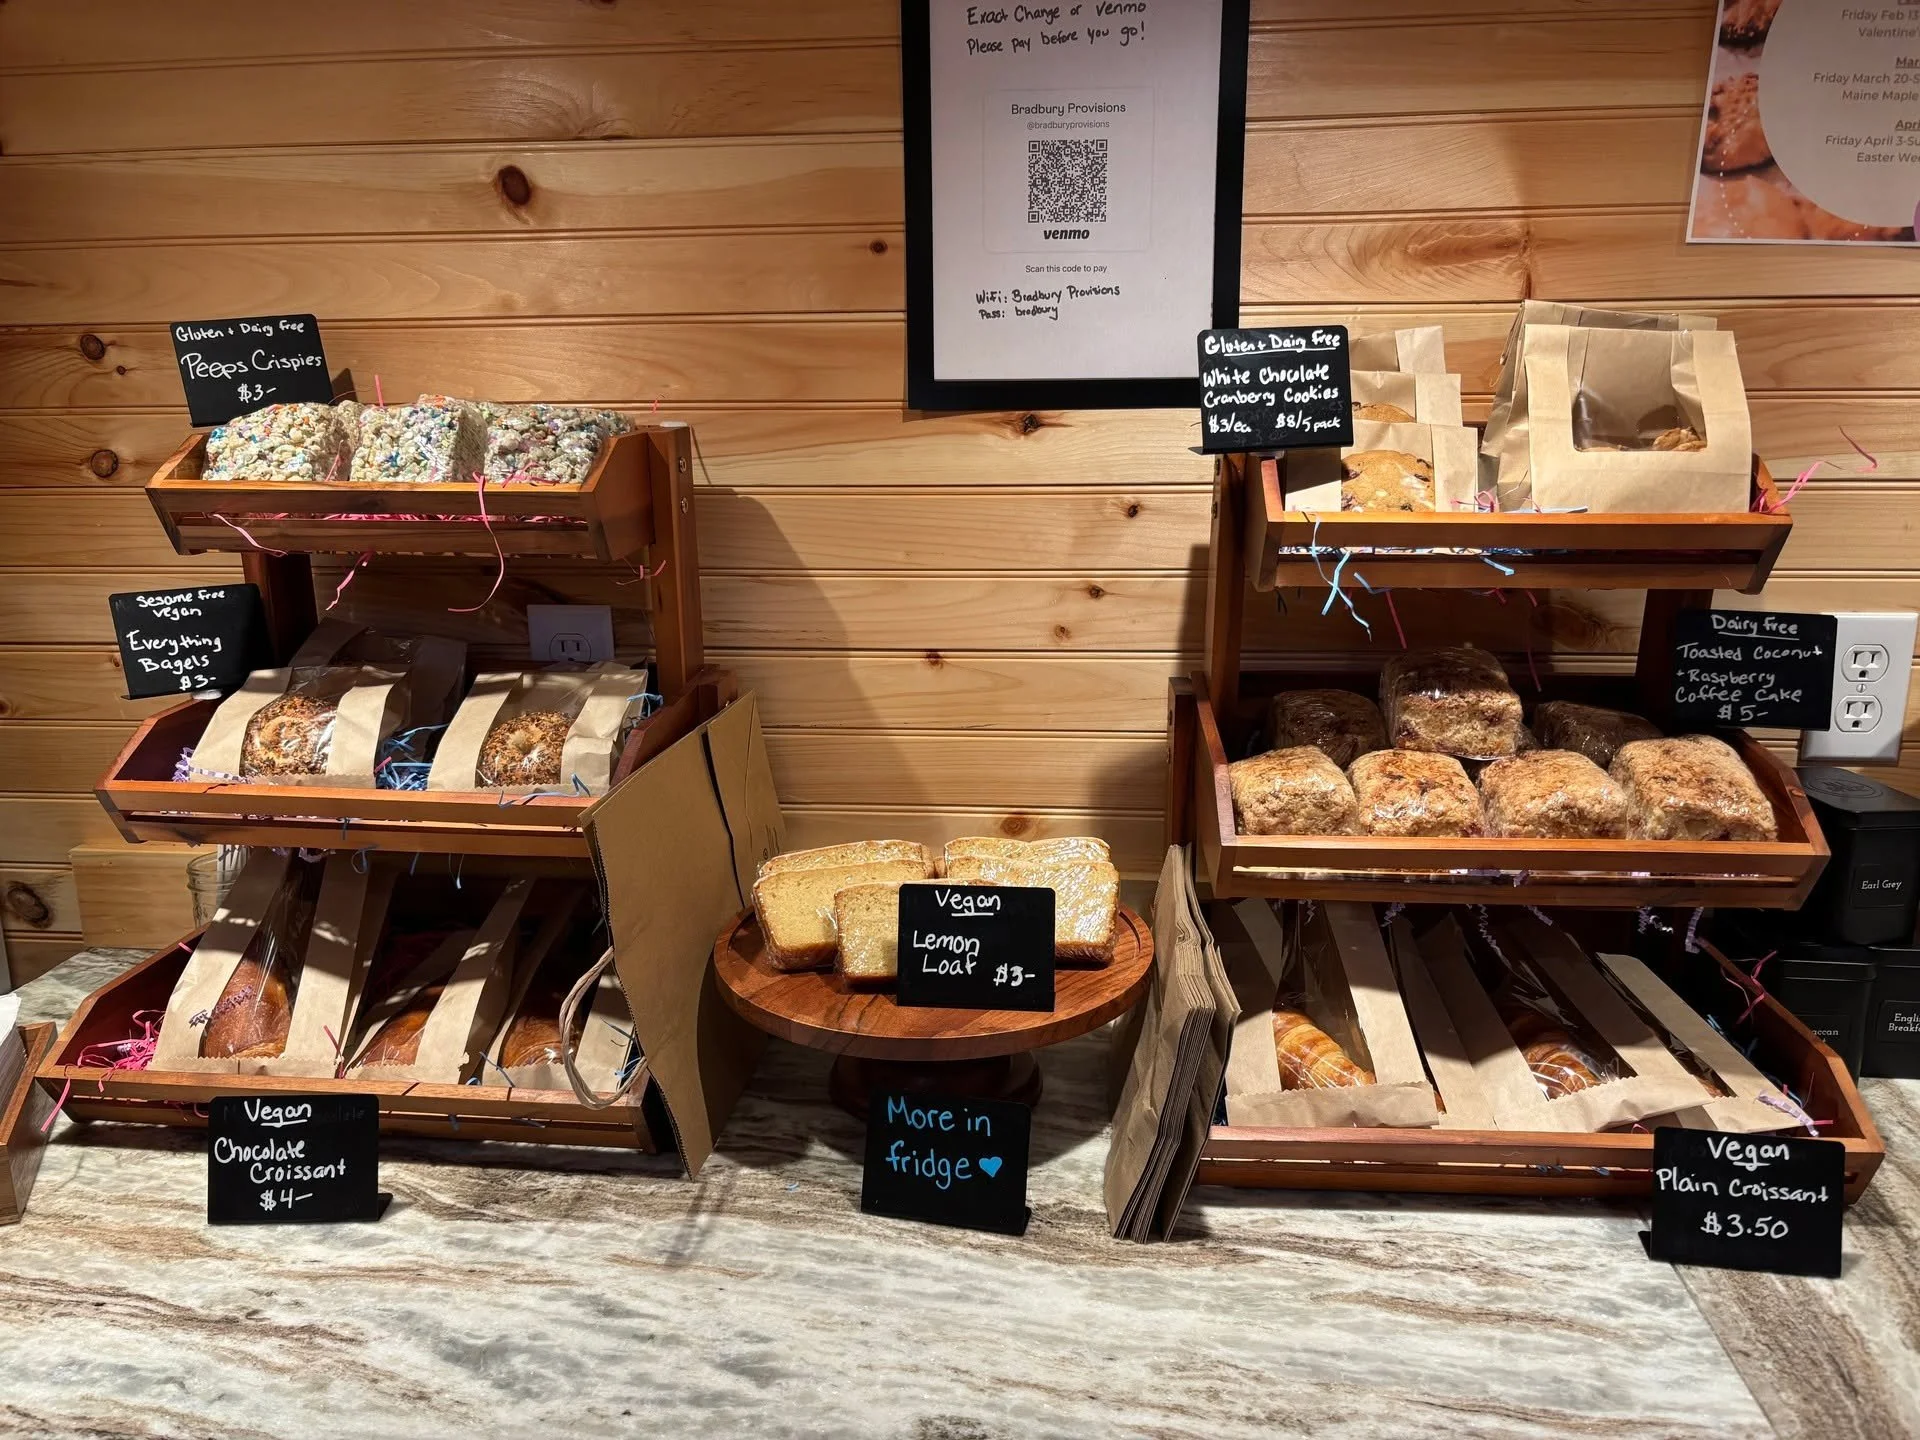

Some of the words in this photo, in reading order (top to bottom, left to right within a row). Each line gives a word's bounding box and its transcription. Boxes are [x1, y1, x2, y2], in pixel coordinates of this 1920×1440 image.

[967, 6, 1008, 25] Exact
[1014, 5, 1060, 24] Change
[1070, 4, 1083, 16] or
[1096, 1, 1147, 16] Venmo
[1841, 9, 1878, 23] Friday
[1881, 9, 1905, 21] Feb
[967, 38, 1003, 55] Please
[1040, 30, 1078, 46] before
[1087, 27, 1109, 45] you
[1120, 20, 1145, 47] go!
[1858, 26, 1920, 38] Valentine'
[1895, 57, 1920, 69] Mar
[1813, 72, 1849, 86] Friday
[1852, 73, 1890, 84] March
[1842, 90, 1879, 101] Maine
[1882, 90, 1919, 103] Maple
[1011, 103, 1065, 117] Bradbury
[1067, 102, 1127, 114] Provisions
[1026, 120, 1110, 131] @bradburyprovisions
[1825, 135, 1862, 148] Friday
[1864, 134, 1893, 148] April
[1857, 152, 1895, 163] Easter
[1043, 229, 1090, 240] venmo
[1025, 265, 1045, 273] Scan
[1046, 265, 1061, 273] this
[1062, 265, 1082, 273] code
[1083, 265, 1092, 273] to
[1093, 266, 1108, 274] pay
[1012, 289, 1062, 304] Bradbury
[1067, 285, 1121, 299] Provisions
[979, 309, 1005, 319] Pass:
[175, 326, 225, 342] Gluten
[240, 323, 273, 337] Dairy
[1205, 335, 1256, 356] Gluten
[1269, 333, 1307, 353] Dairy
[181, 353, 248, 379] Peeps
[252, 350, 322, 371] Crispies
[1203, 367, 1251, 388] White
[1259, 363, 1330, 385] Chocolate
[1204, 390, 1276, 408] Cranberry
[1284, 384, 1339, 404] Cookies
[1711, 614, 1758, 636] Dairy
[126, 629, 222, 656] Everything
[1676, 642, 1743, 661] Toasted
[1753, 645, 1823, 660] Coconut
[138, 654, 210, 675] Bagels
[1675, 685, 1743, 703] Coffee
[1754, 688, 1803, 703] Cake
[1861, 879, 1880, 890] Earl
[1881, 879, 1903, 891] Grey
[935, 889, 1002, 913] Vegan
[913, 930, 980, 957] Lemon
[922, 951, 977, 976] Loaf
[1894, 1012, 1920, 1025] Engli
[243, 1098, 312, 1127] Vegan
[887, 1095, 955, 1132] More
[963, 1107, 991, 1137] in
[214, 1136, 306, 1164] Chocolate
[1706, 1136, 1790, 1171] Vegan
[250, 1157, 347, 1184] Croissant
[885, 1139, 973, 1190] fridge
[1656, 1167, 1719, 1196] Plain
[1728, 1178, 1829, 1203] Croissant
[1700, 1211, 1789, 1239] $3.50
